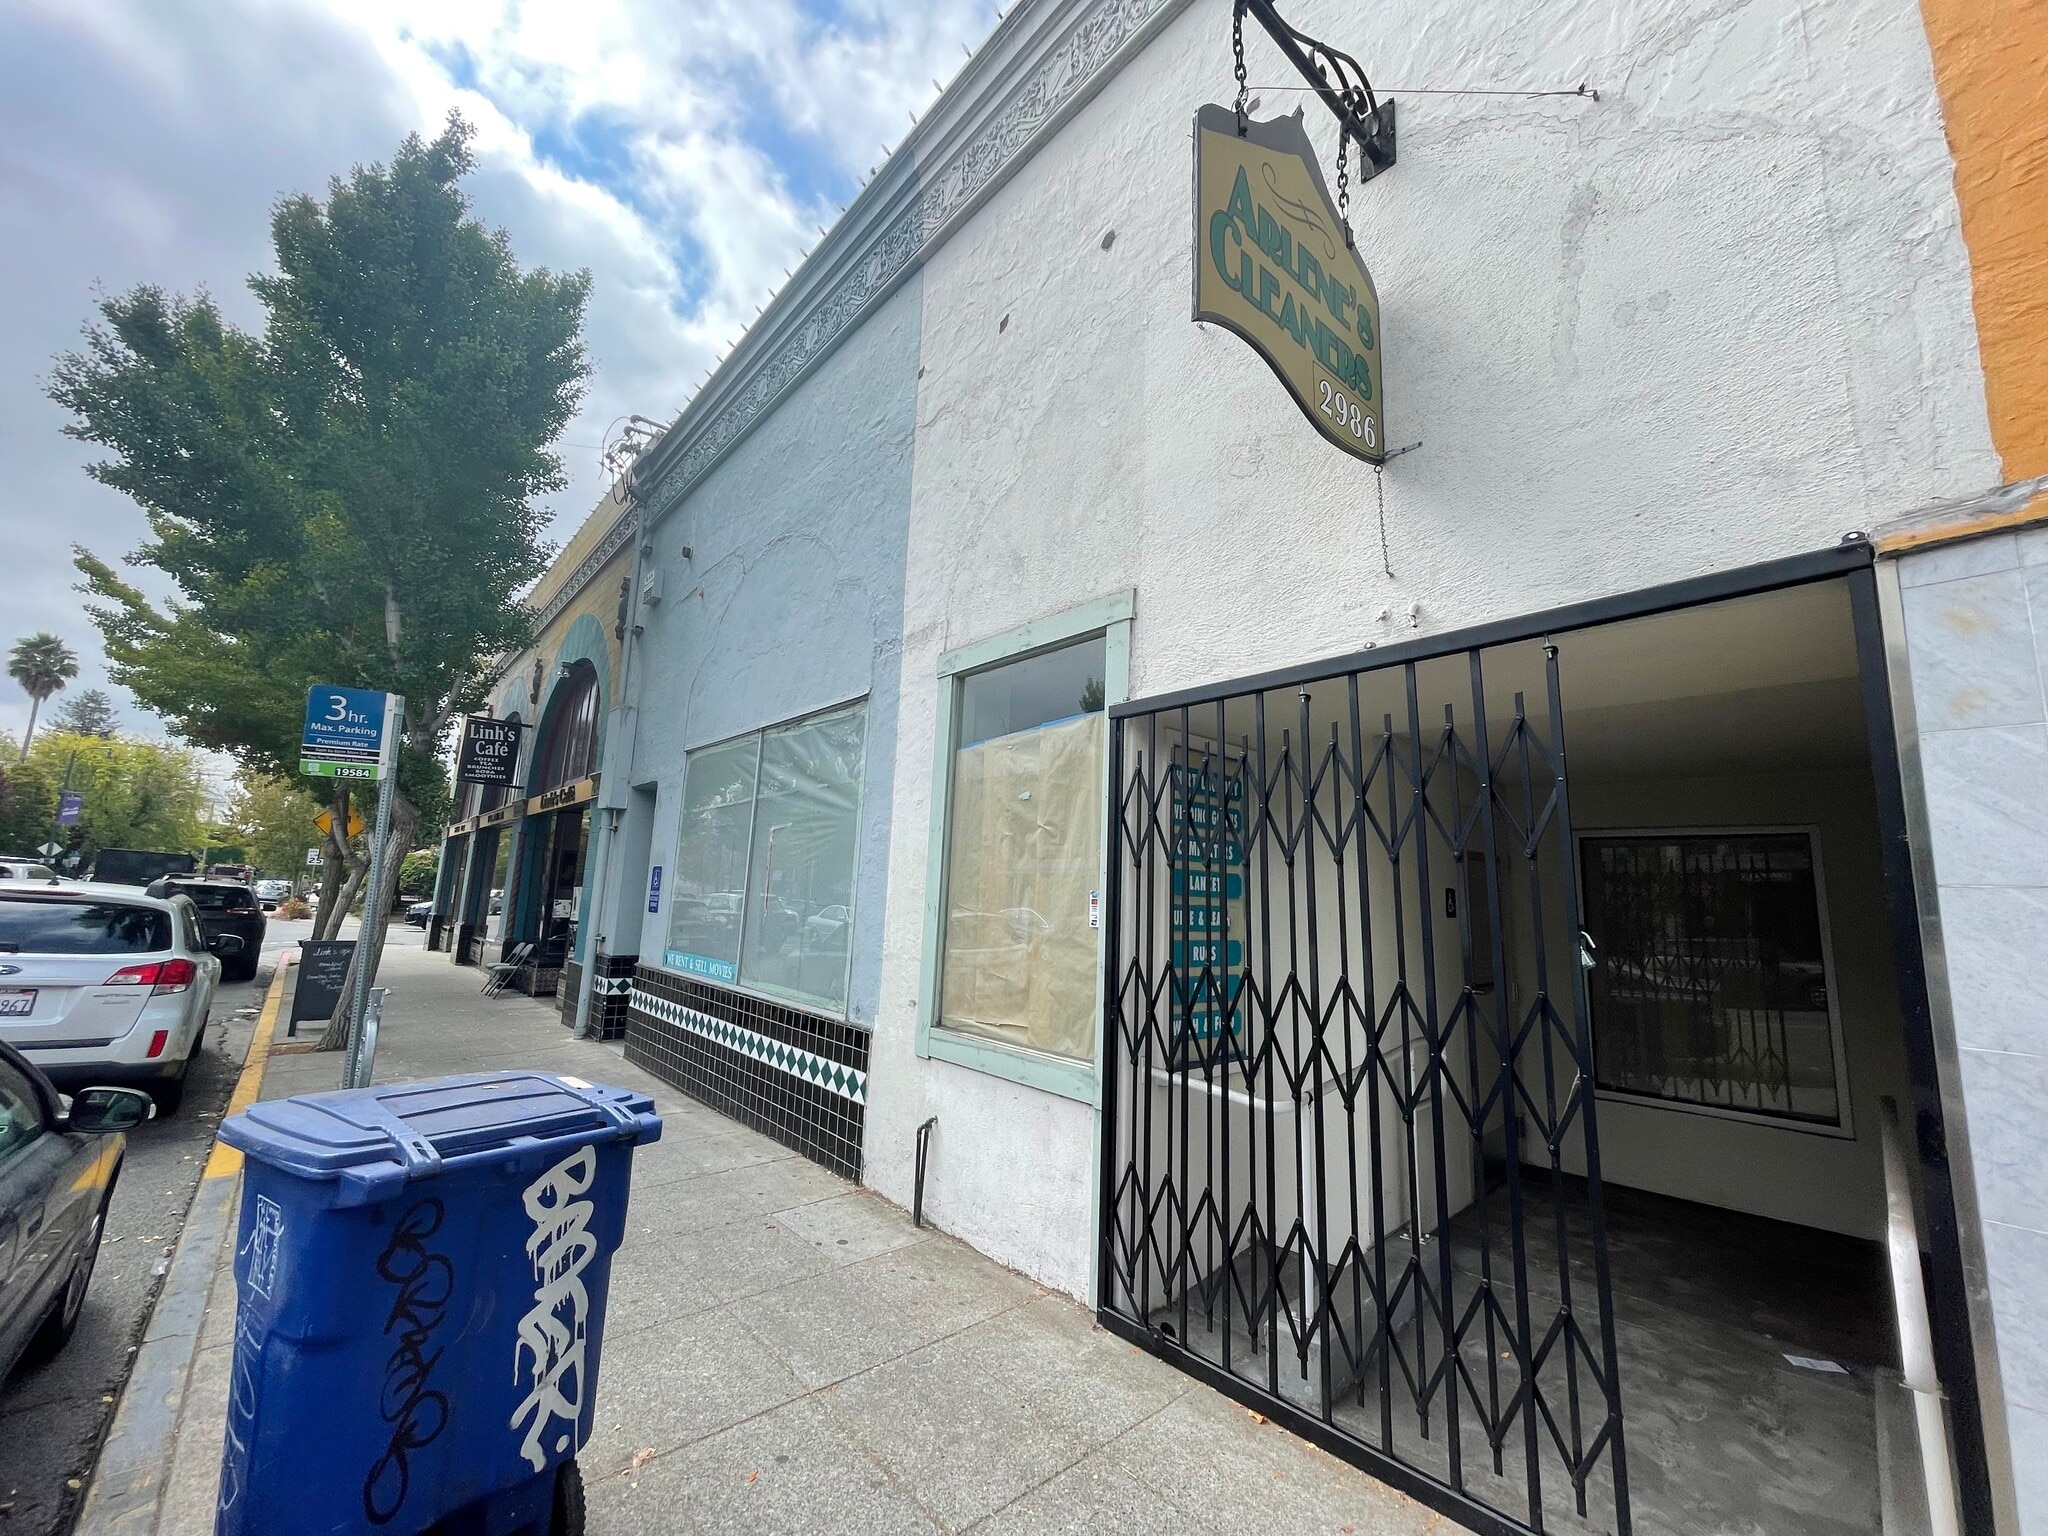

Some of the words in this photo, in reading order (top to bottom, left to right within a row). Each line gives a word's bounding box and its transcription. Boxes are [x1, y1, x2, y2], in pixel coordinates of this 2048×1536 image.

[1227, 164, 1374, 351] ARLENE'S
[1209, 208, 1373, 402] CLEANERS
[1319, 379, 1377, 449] 2986
[325, 695, 347, 721] 3
[348, 710, 368, 724] hr.
[310, 722, 336, 732] Max.
[338, 725, 377, 737] Parking
[469, 724, 516, 741] Linh's
[316, 737, 351, 747] Premium
[351, 740, 369, 748] Rate
[475, 740, 509, 756] Café
[335, 768, 370, 777] 19584
[675, 955, 689, 969] RENT
[694, 960, 707, 973] SELL
[709, 962, 732, 979] MOVIES
